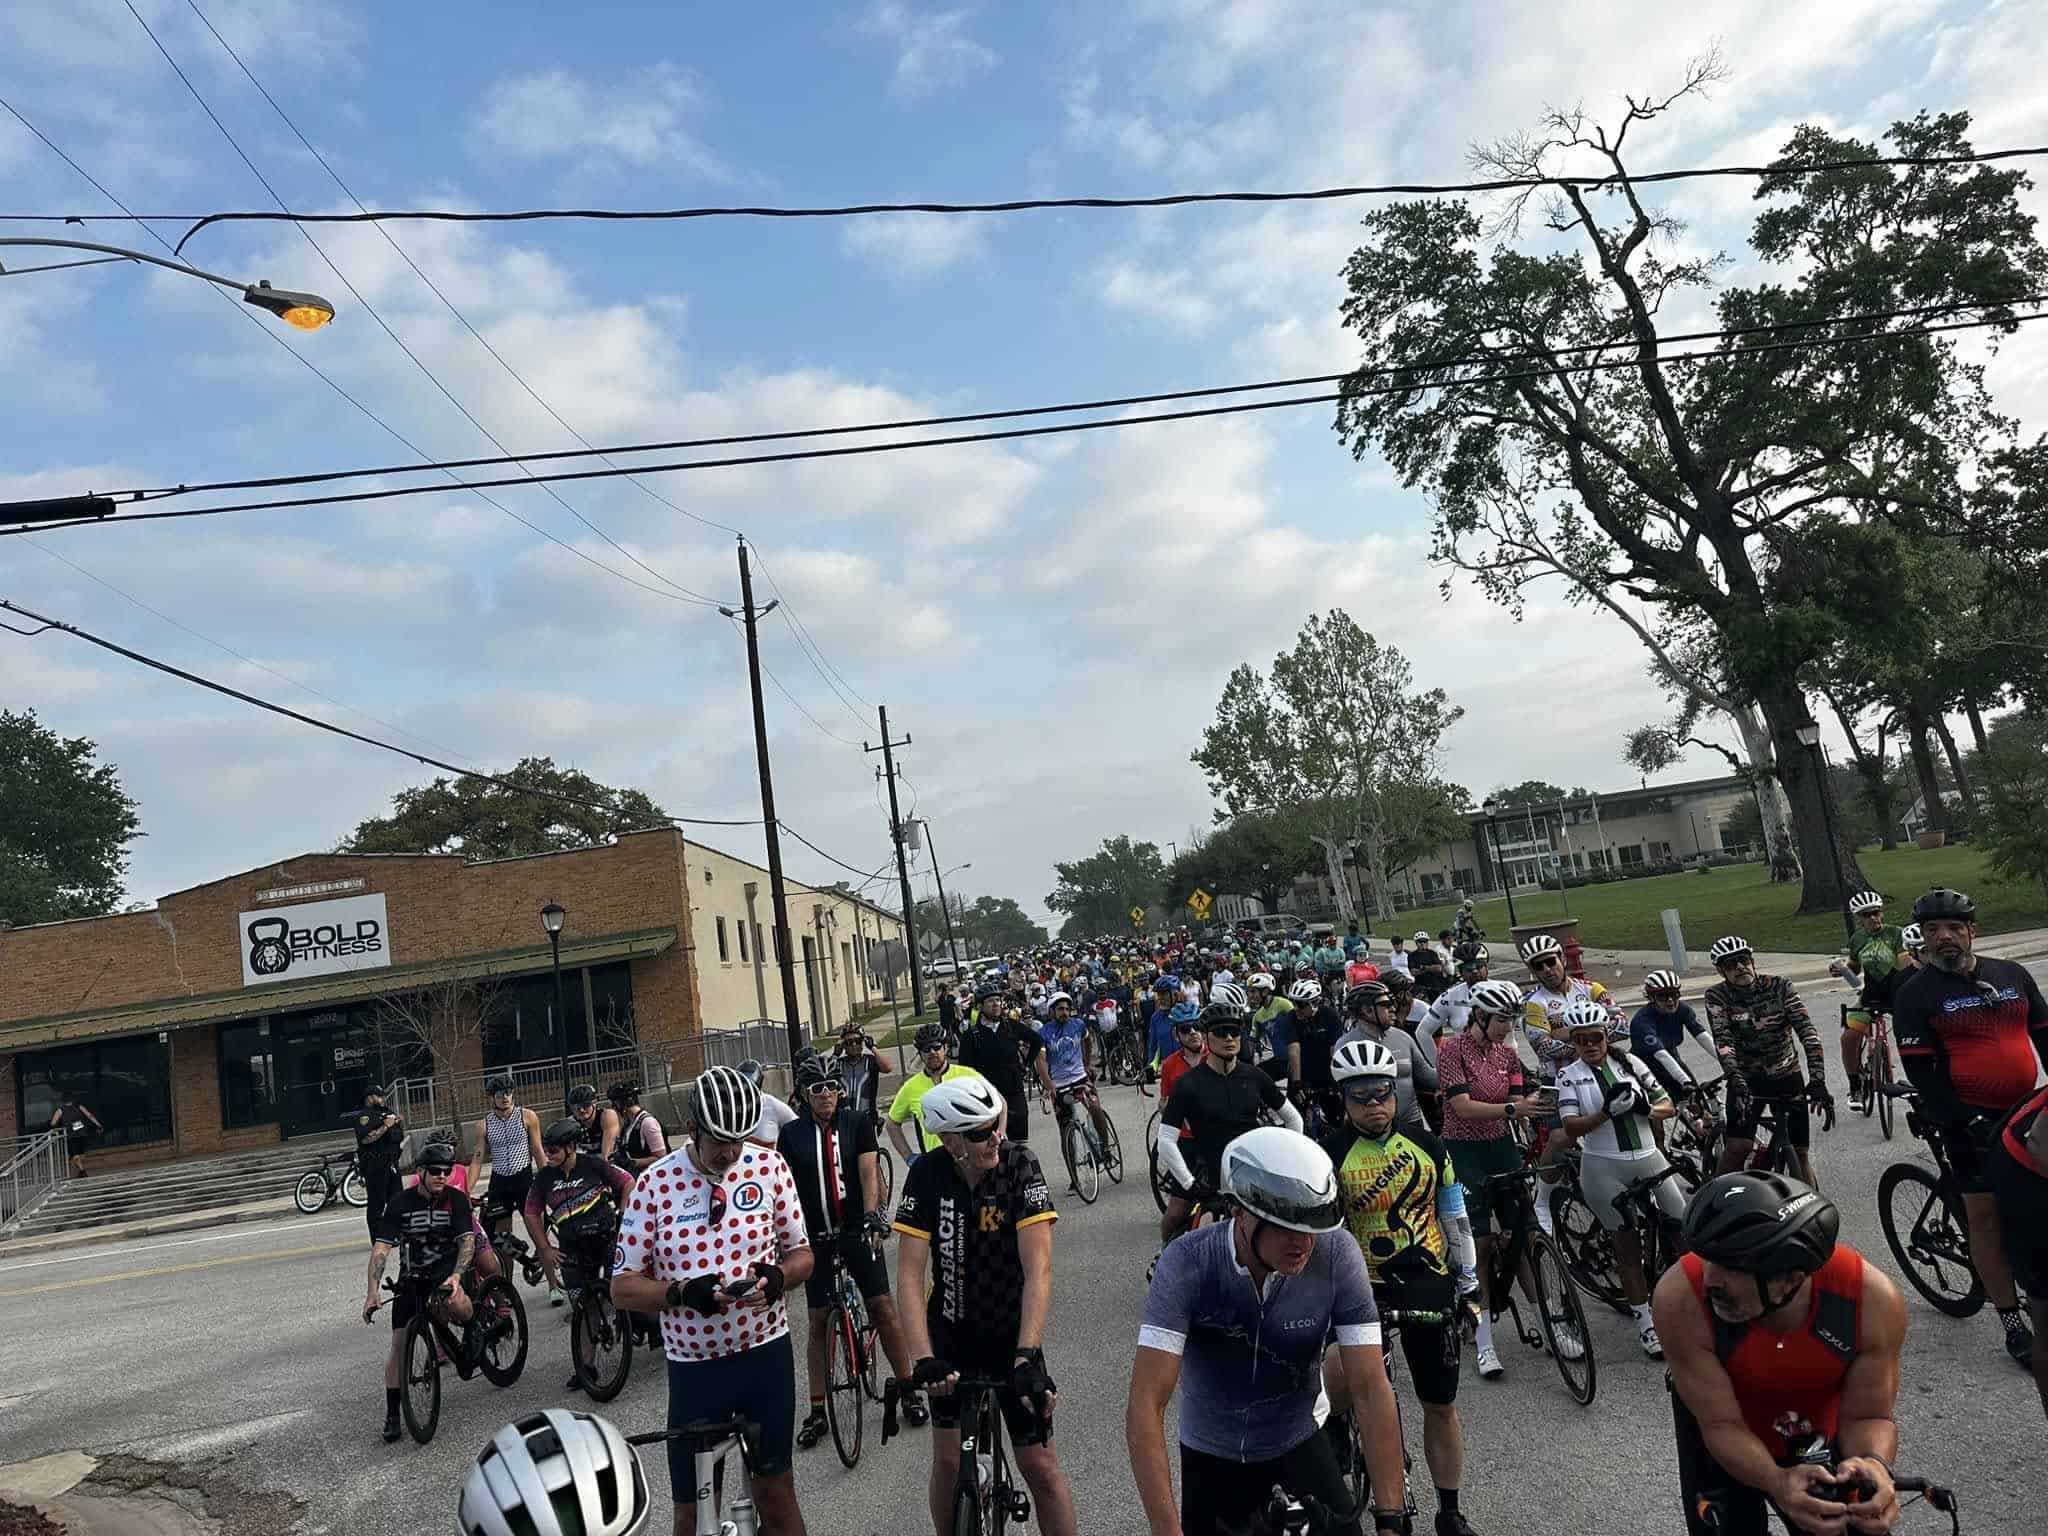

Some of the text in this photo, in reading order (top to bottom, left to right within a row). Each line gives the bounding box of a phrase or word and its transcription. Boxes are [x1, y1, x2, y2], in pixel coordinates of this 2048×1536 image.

[289, 920, 379, 949] BOLD
[291, 939, 382, 963] FITNESS
[1353, 1151, 1412, 1209] WINGMAN
[1778, 1192, 1817, 1221] S-WORKS
[957, 1212, 966, 1263] COMPANY
[938, 1197, 956, 1323] KARBACH
